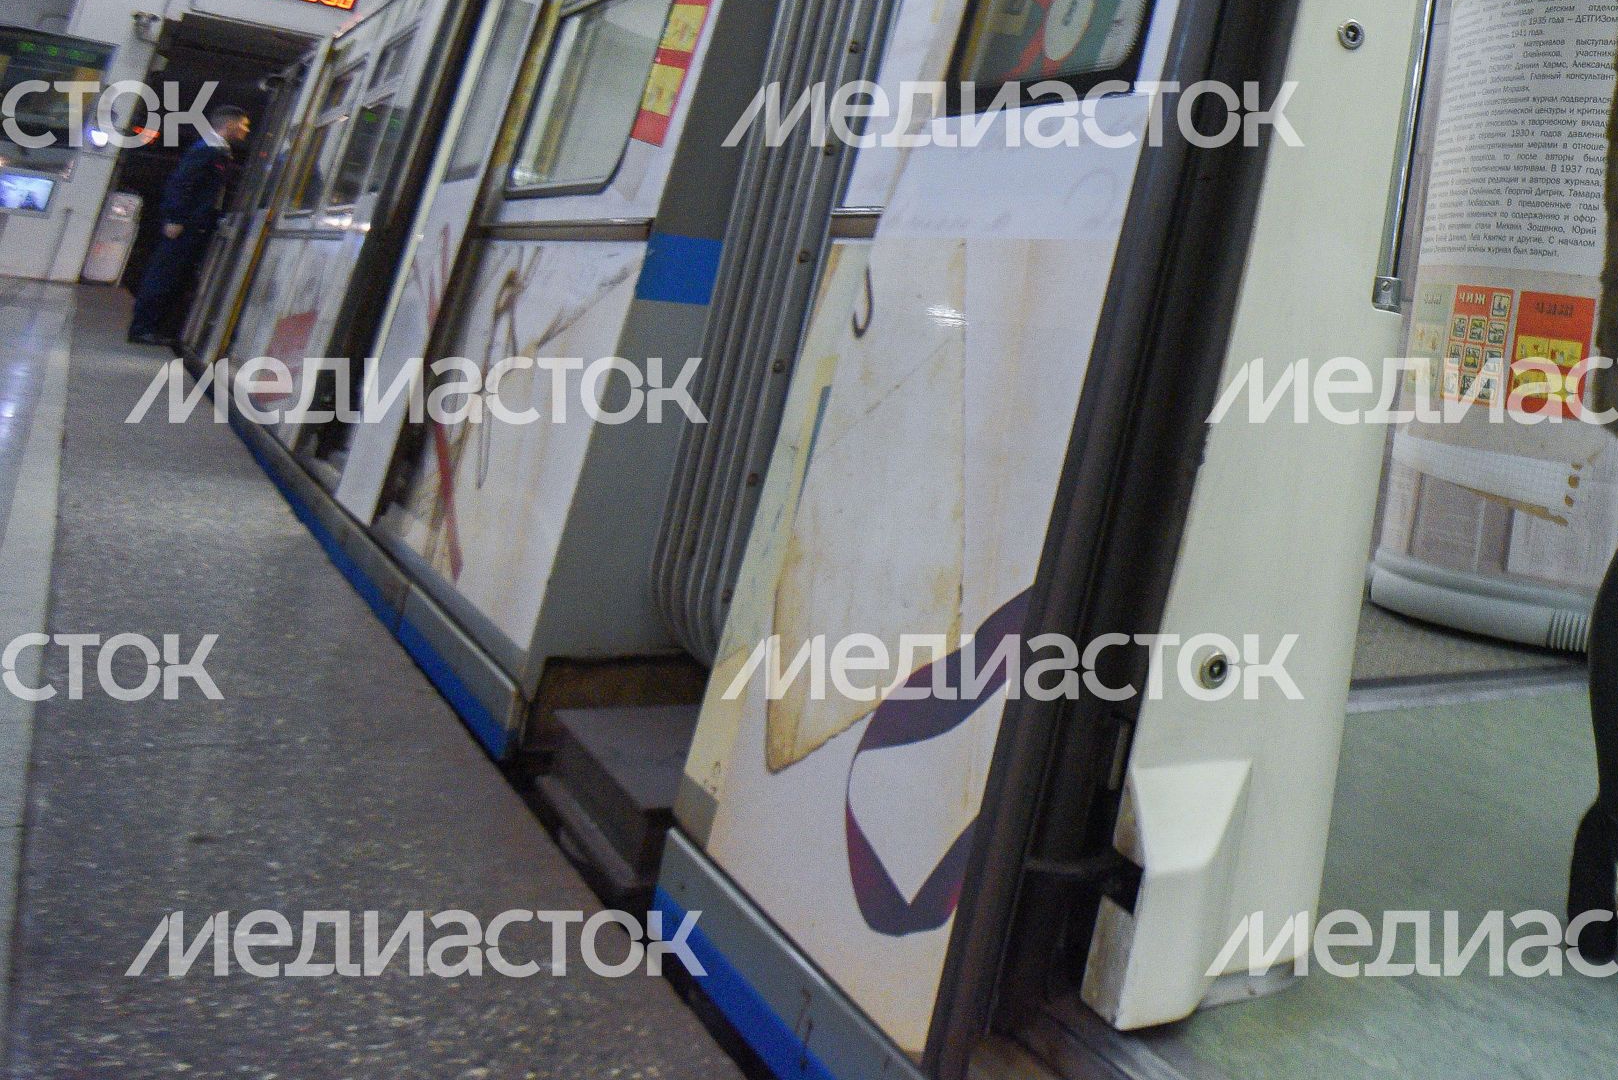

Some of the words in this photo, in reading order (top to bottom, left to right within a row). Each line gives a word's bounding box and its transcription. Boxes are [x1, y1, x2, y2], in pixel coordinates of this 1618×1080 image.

[1566, 73, 1616, 82] консультант
[1560, 95, 1612, 105] подвергался
[1576, 107, 1611, 117] критике
[1528, 119, 1578, 128] творческому
[1560, 163, 1583, 173] 1937
[1529, 176, 1561, 186] авторов
[1568, 189, 1602, 200] Тамара
[1518, 199, 1573, 210] предвоенные
[1579, 201, 1601, 212] годы
[1526, 222, 1566, 234] Зощенко,
[1572, 224, 1598, 236] Юрий
[1558, 238, 1596, 248] началом
[1458, 291, 1487, 305] ЧИЖ
